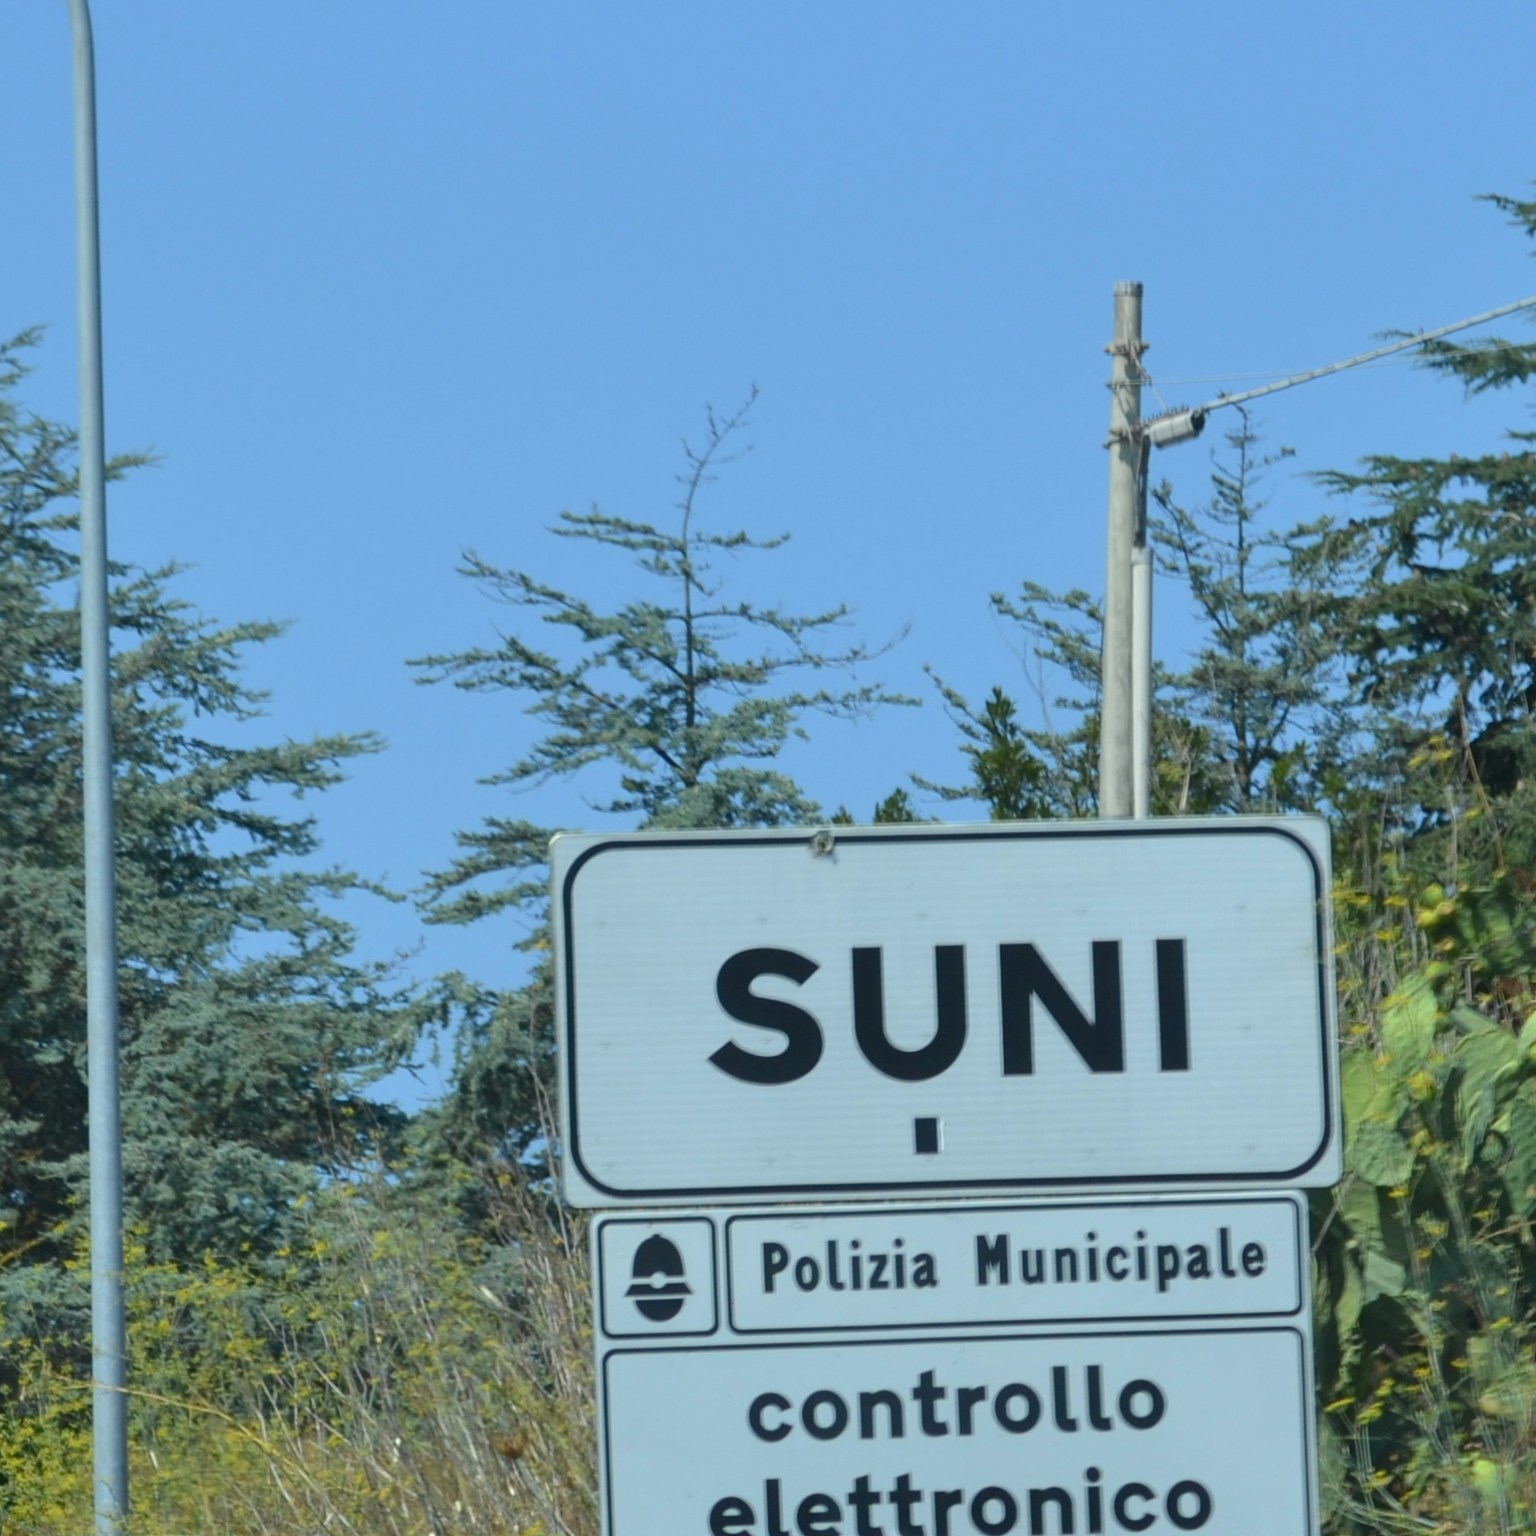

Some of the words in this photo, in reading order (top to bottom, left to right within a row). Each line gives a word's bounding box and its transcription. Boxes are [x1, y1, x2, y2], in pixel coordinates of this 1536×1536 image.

[708, 938, 1190, 1086] SUNI
[761, 1237, 940, 1294] Polizia
[975, 1226, 1267, 1294] Municipale
[747, 1364, 1166, 1443] controllo
